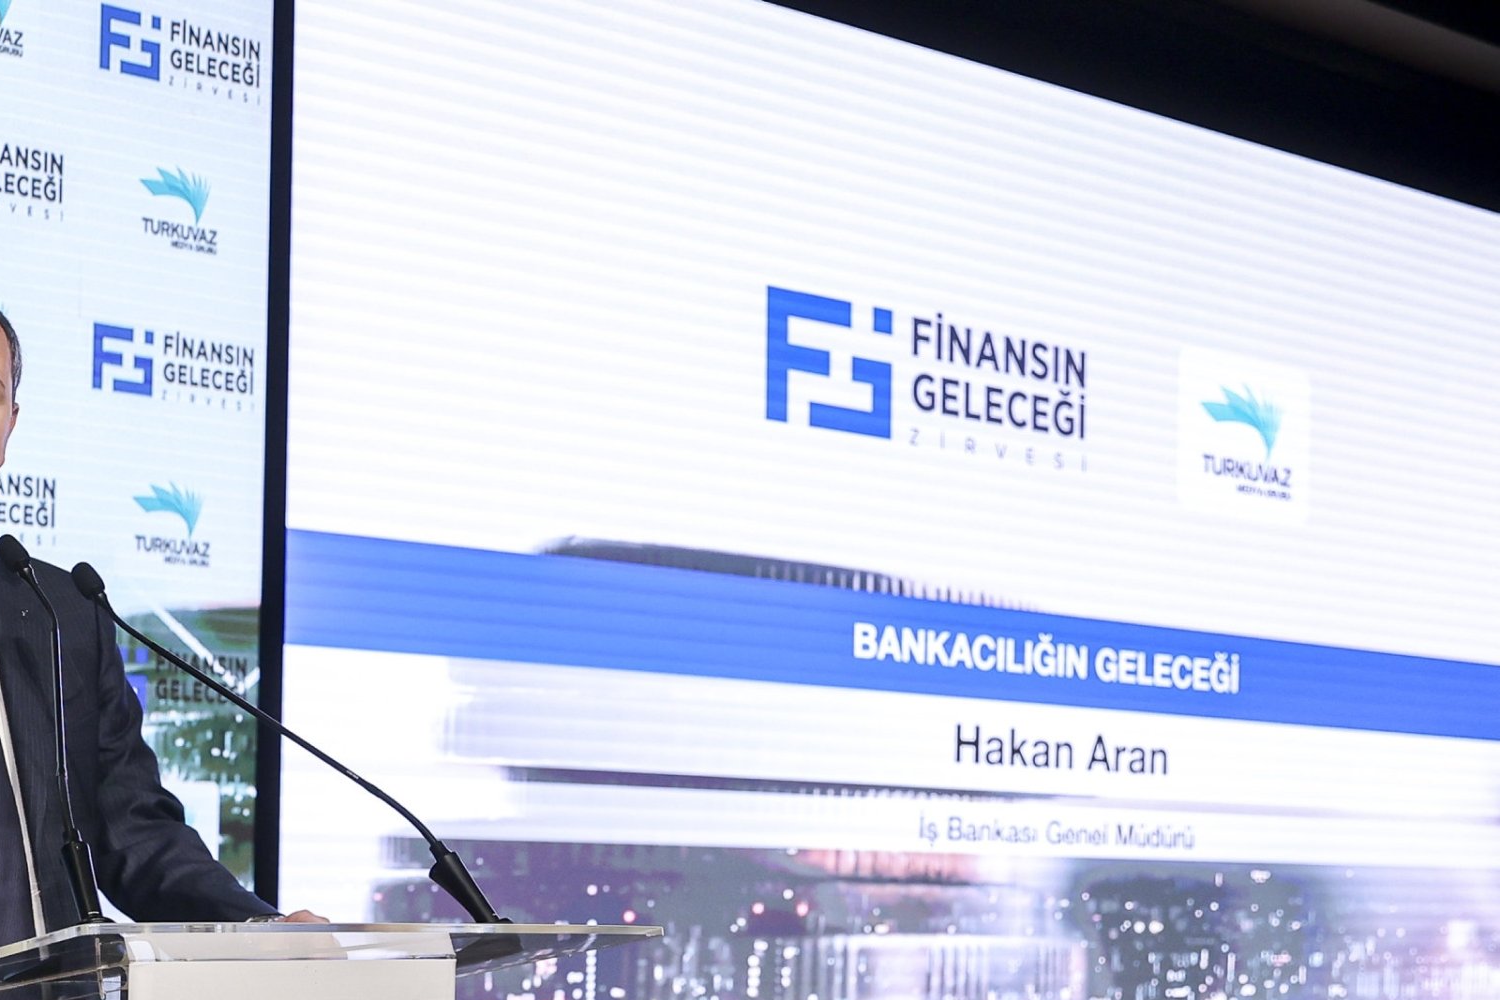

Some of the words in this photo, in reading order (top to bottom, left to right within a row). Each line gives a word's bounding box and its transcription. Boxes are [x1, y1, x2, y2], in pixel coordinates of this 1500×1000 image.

[170, 19, 260, 60] FİNANSIN
[170, 50, 260, 88] GELECEĞİ
[142, 217, 217, 245] TURKUVAZ
[164, 332, 254, 368] FİNANSIN
[913, 312, 1086, 388] FİNANSIN
[164, 363, 254, 395] GELECEĞİ
[912, 374, 1086, 440] GELECEĞİ
[1203, 454, 1292, 488] TURKUVAZ
[134, 535, 210, 558] TURKUVAZ
[852, 621, 1088, 680] BANKACILIĞIN
[1094, 648, 1240, 694] GELECEĞİ
[955, 724, 1073, 768] Hakan
[1087, 734, 1168, 775] Aran
[948, 816, 1036, 843] Bankası
[1046, 820, 1110, 846] Genel
[1116, 825, 1195, 849] Müdürü
